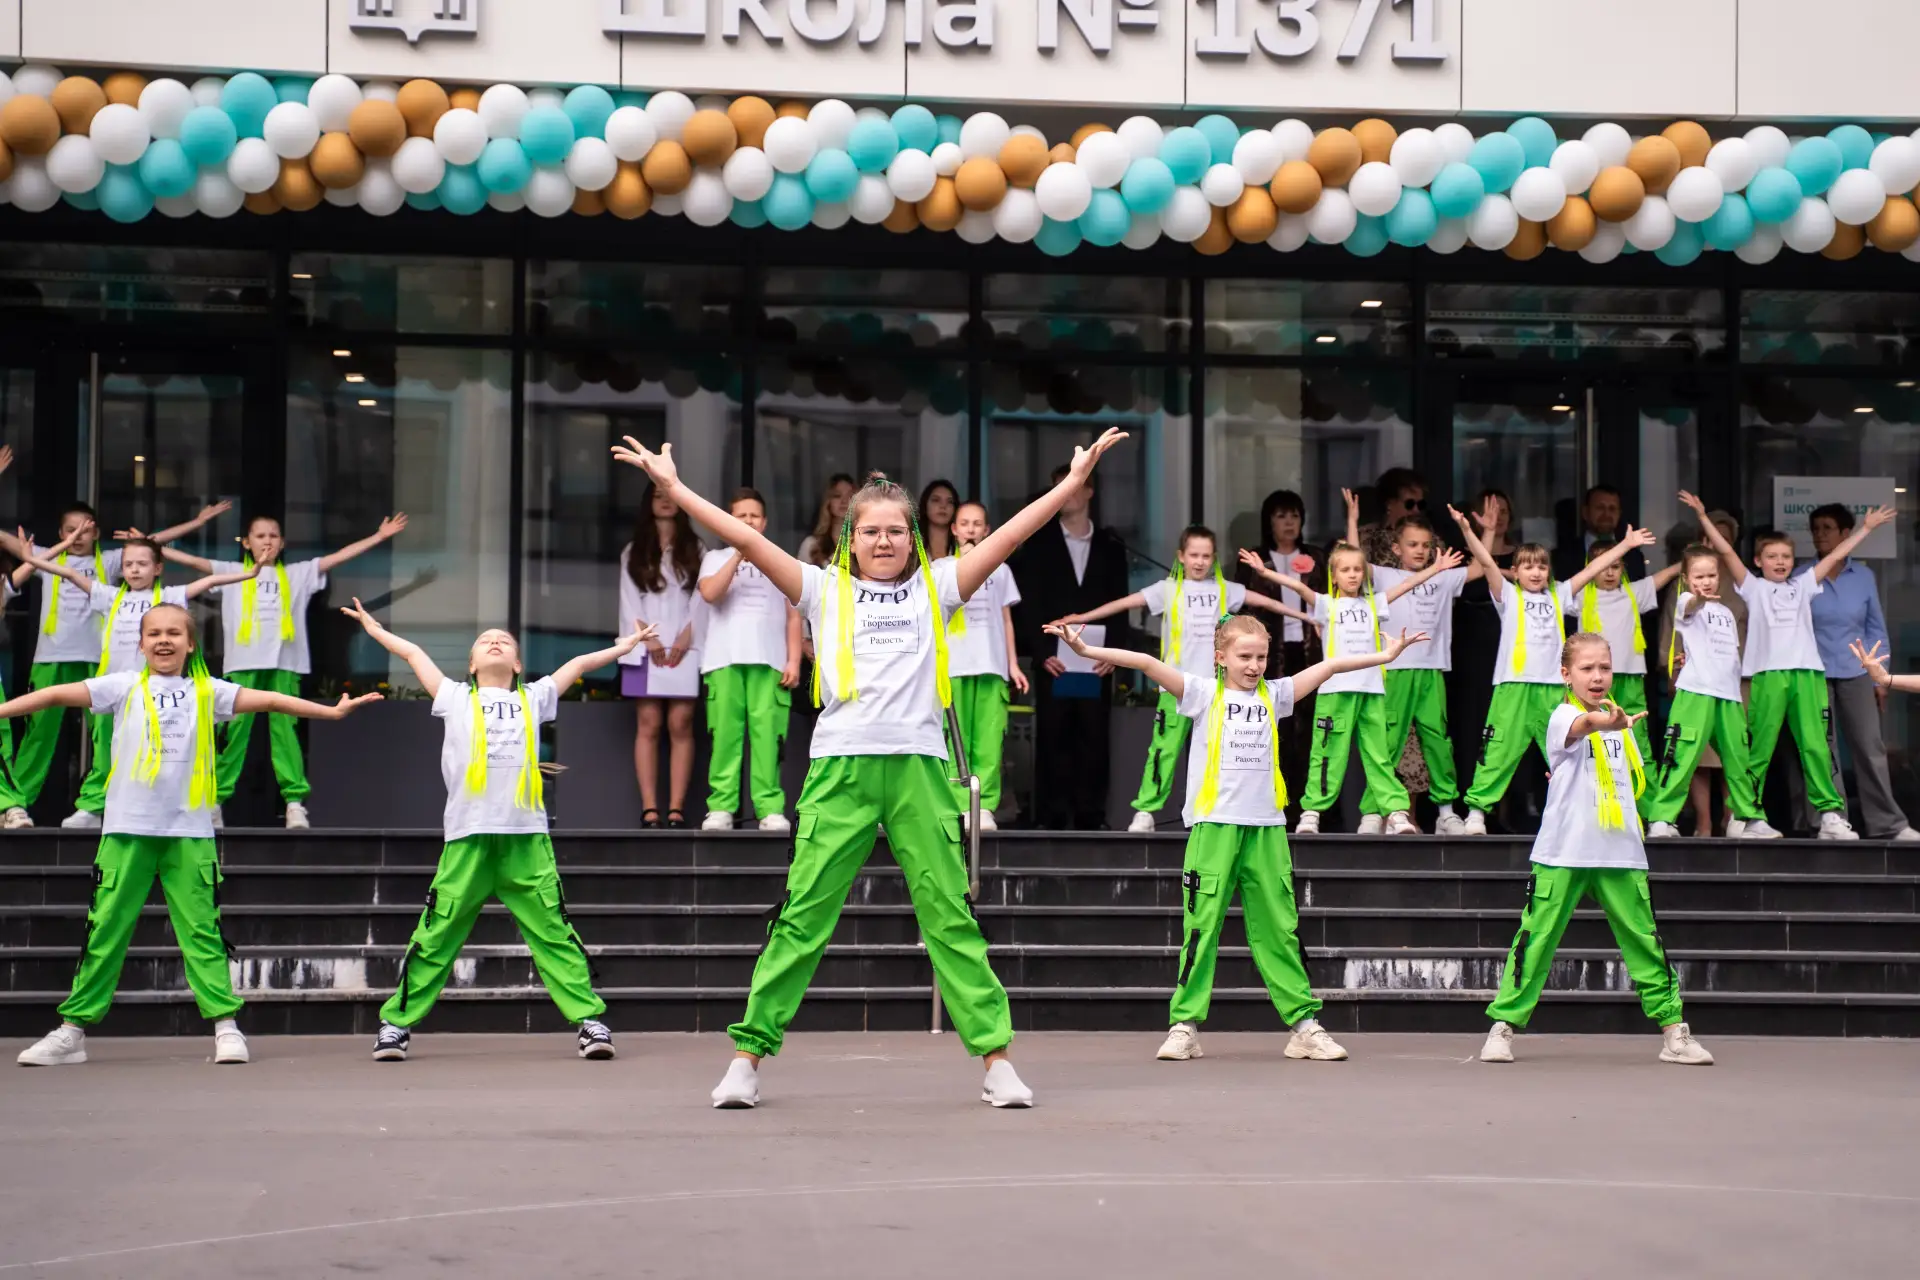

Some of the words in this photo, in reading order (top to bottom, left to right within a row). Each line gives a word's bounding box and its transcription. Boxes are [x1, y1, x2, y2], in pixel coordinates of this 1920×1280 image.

[1195, 0, 1447, 61] 1371
[857, 588, 909, 604] РТР
[1187, 594, 1217, 608] РТР
[1339, 609, 1367, 623] РТР
[861, 619, 912, 629] Творчество
[870, 636, 904, 645] Радость
[482, 701, 522, 719] РТР
[1227, 703, 1268, 722] РТР
[1229, 741, 1267, 749] Творчество
[1235, 755, 1262, 763] Радость
